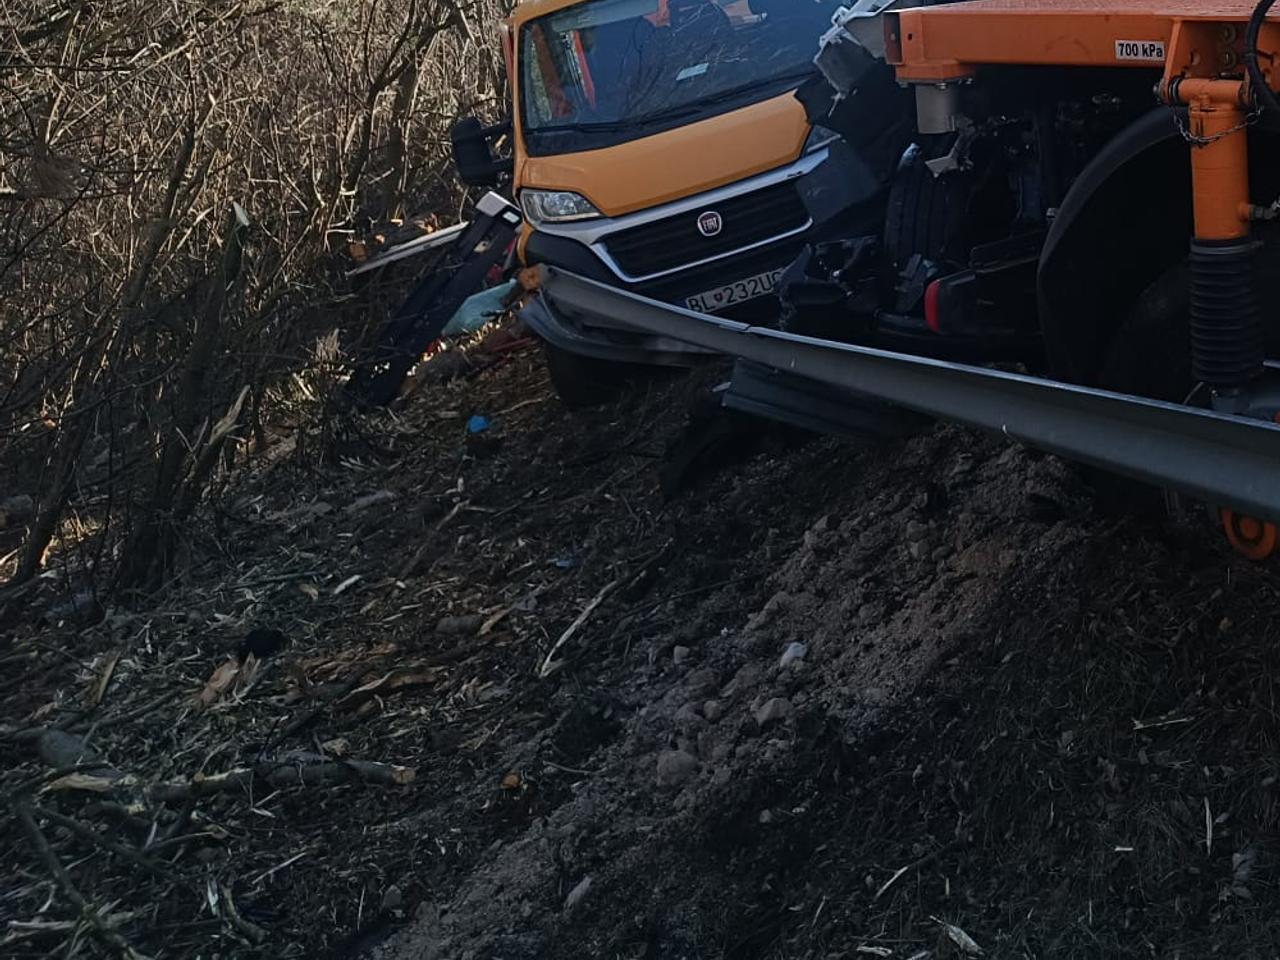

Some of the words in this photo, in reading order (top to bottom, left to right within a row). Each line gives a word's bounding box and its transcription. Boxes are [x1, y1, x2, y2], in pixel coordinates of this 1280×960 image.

[1118, 43, 1138, 57] 700
[1141, 43, 1163, 58] kPa
[701, 217, 718, 231] FIAT
